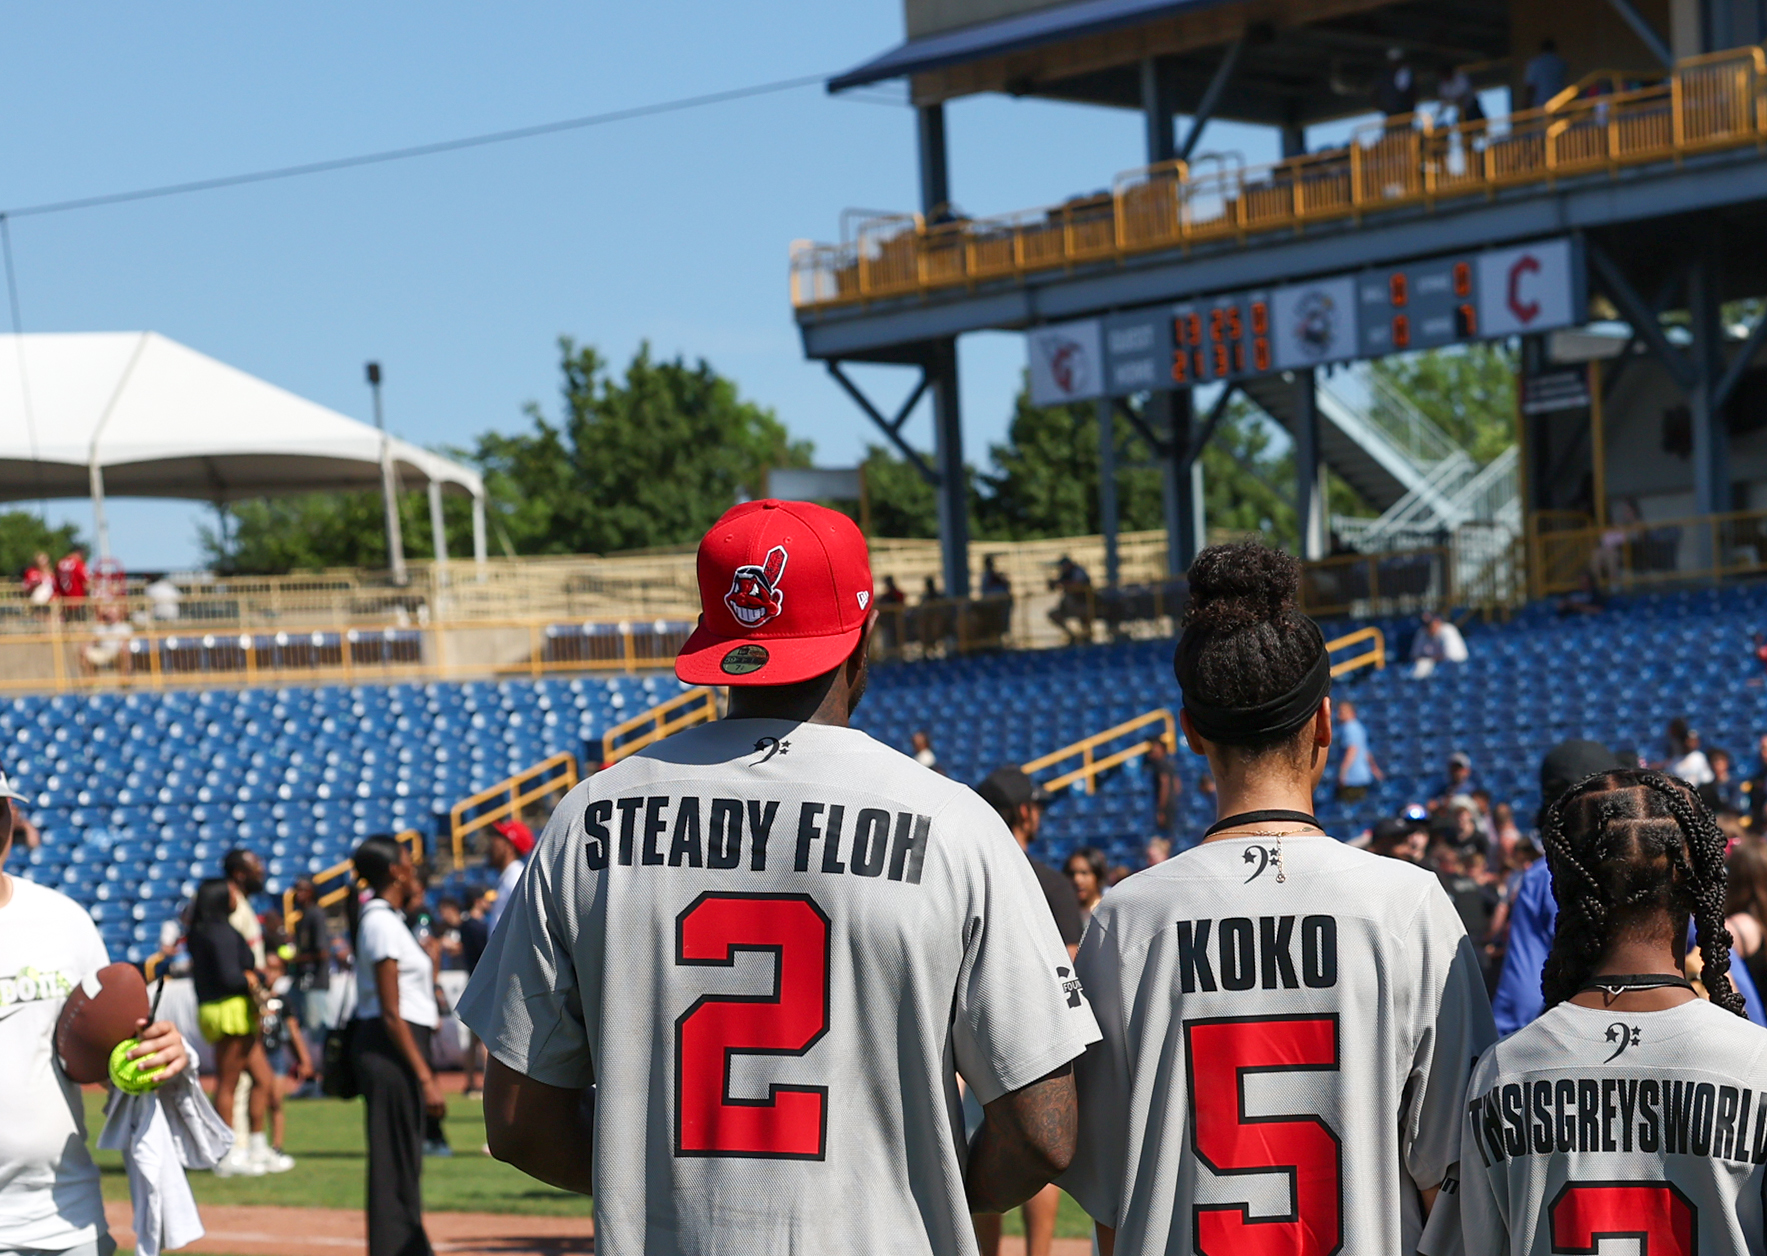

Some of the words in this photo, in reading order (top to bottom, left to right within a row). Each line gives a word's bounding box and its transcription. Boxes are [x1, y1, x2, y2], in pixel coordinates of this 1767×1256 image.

[584, 796, 781, 872] STEADY
[794, 802, 932, 885] FLOH
[1176, 914, 1338, 995] KOKO
[673, 890, 833, 1162] 2
